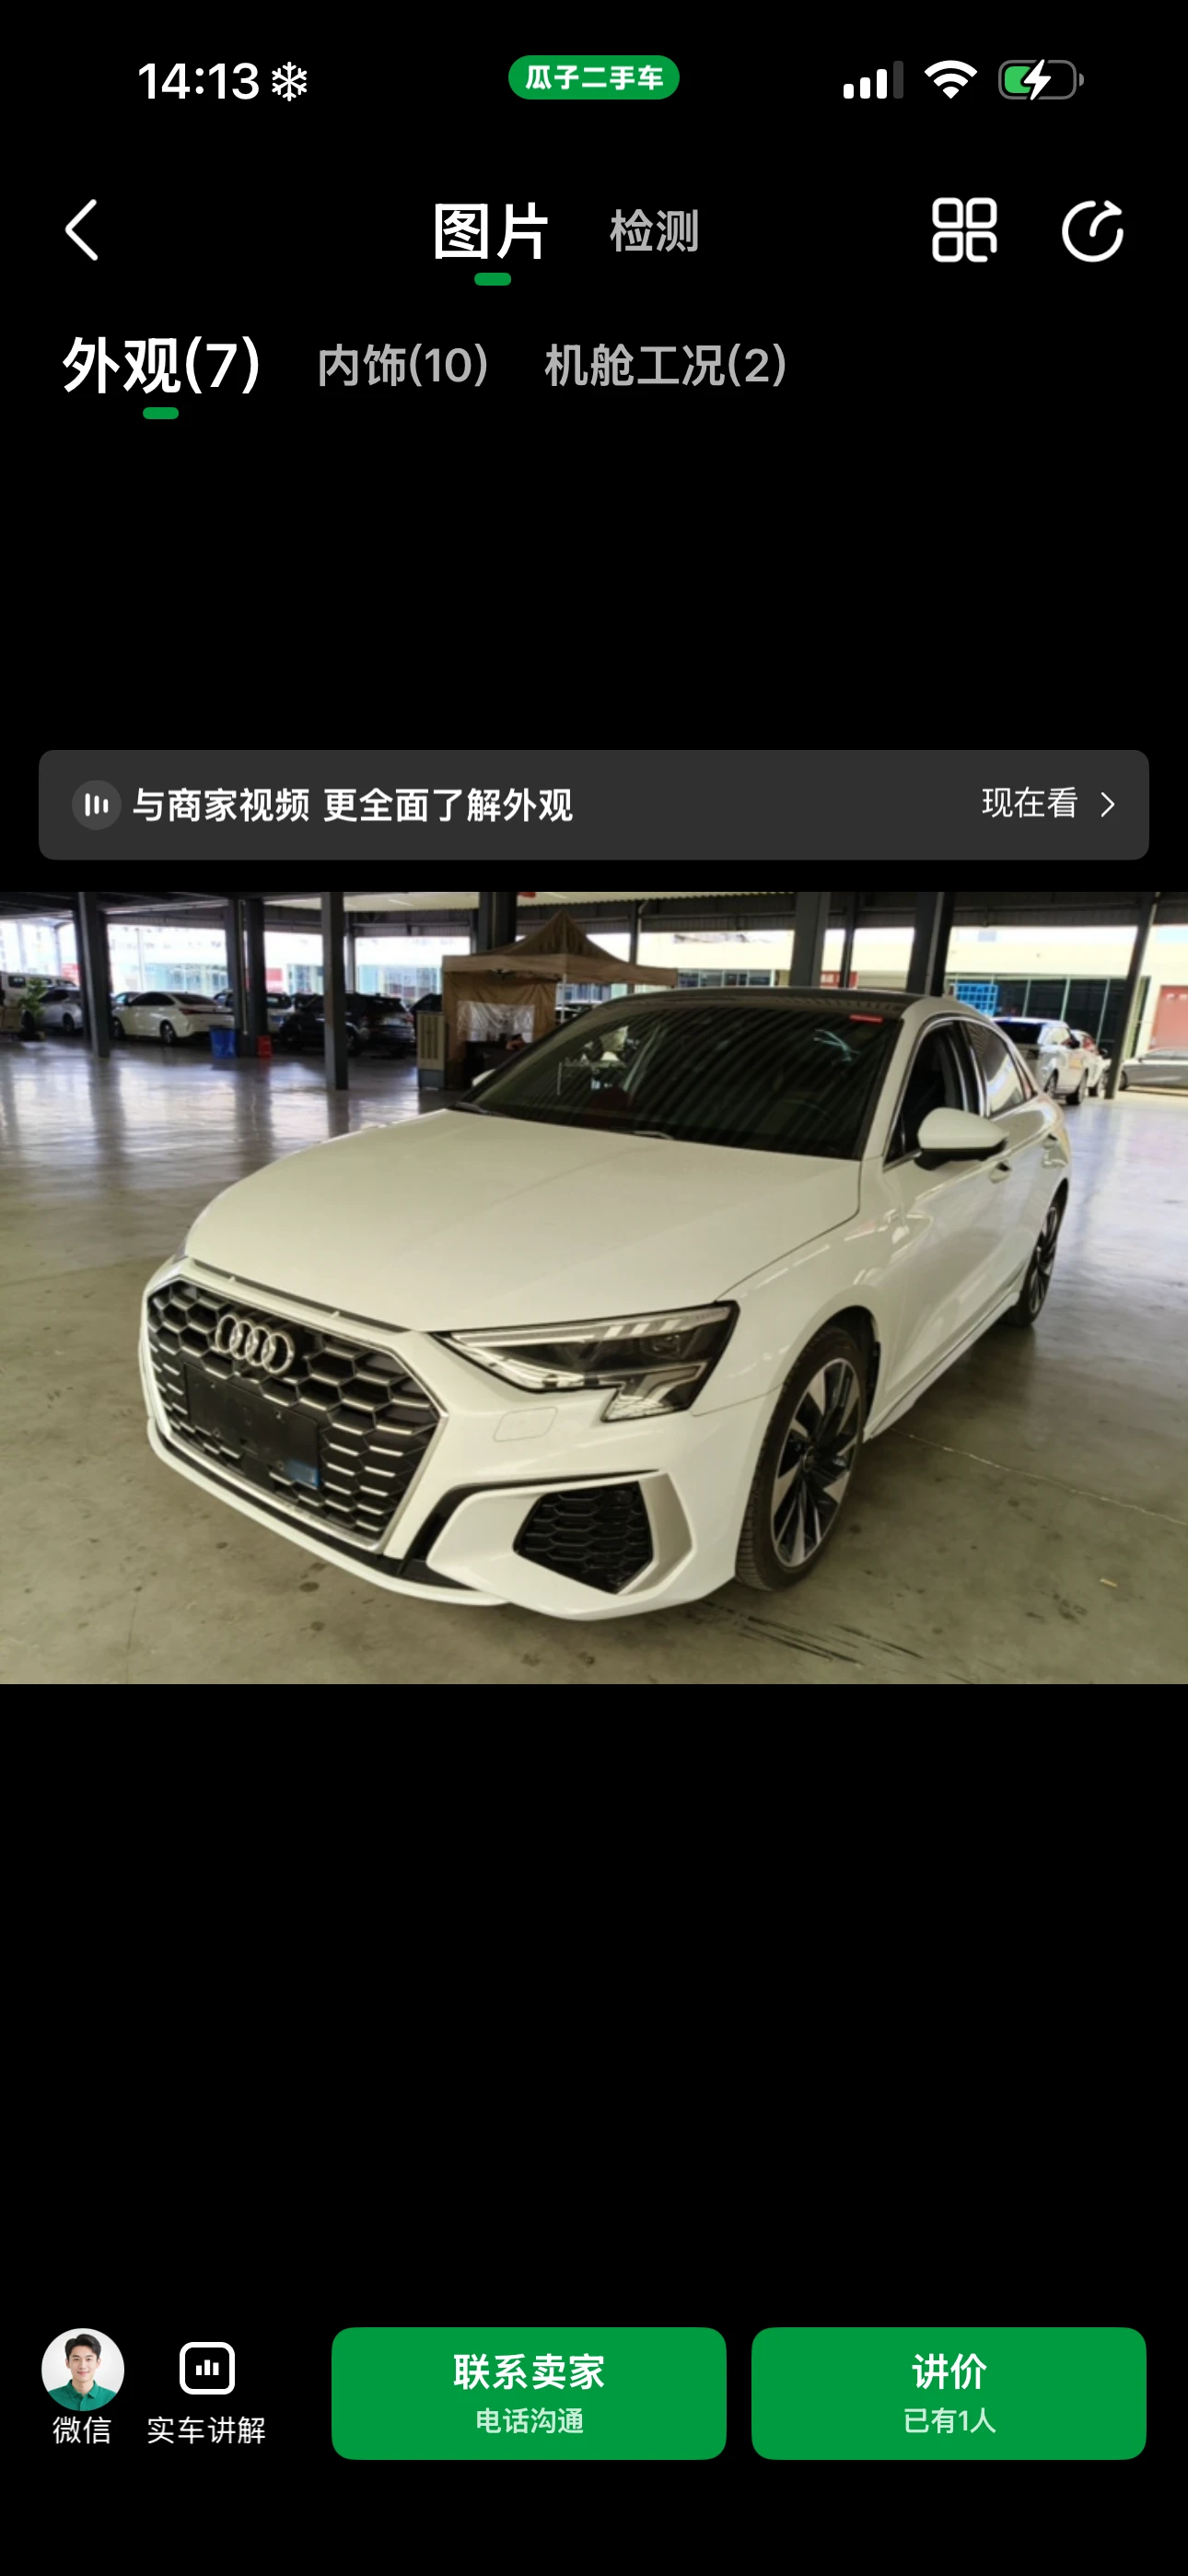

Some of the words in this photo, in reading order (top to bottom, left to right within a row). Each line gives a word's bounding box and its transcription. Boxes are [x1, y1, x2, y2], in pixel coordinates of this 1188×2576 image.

[139, 63, 259, 100] 14:13
[526, 64, 663, 90] 瓜子二手车
[436, 202, 548, 259] 图片
[610, 209, 698, 252] 检测
[63, 336, 258, 393] 外观(7)
[320, 344, 486, 386] 内饰(10)
[545, 344, 785, 386] 机舱工况(2)
[134, 788, 309, 822] 与商家视频
[324, 788, 573, 822] 更全面了解外观
[983, 787, 1077, 818] 现在看
[454, 2353, 604, 2390] 联系卖家
[912, 2353, 986, 2389] 讲价
[53, 2417, 111, 2443] 微信
[148, 2417, 265, 2444] 实车讲解
[477, 2407, 583, 2433] 电话沟通
[904, 2407, 996, 2433] 已有1人
